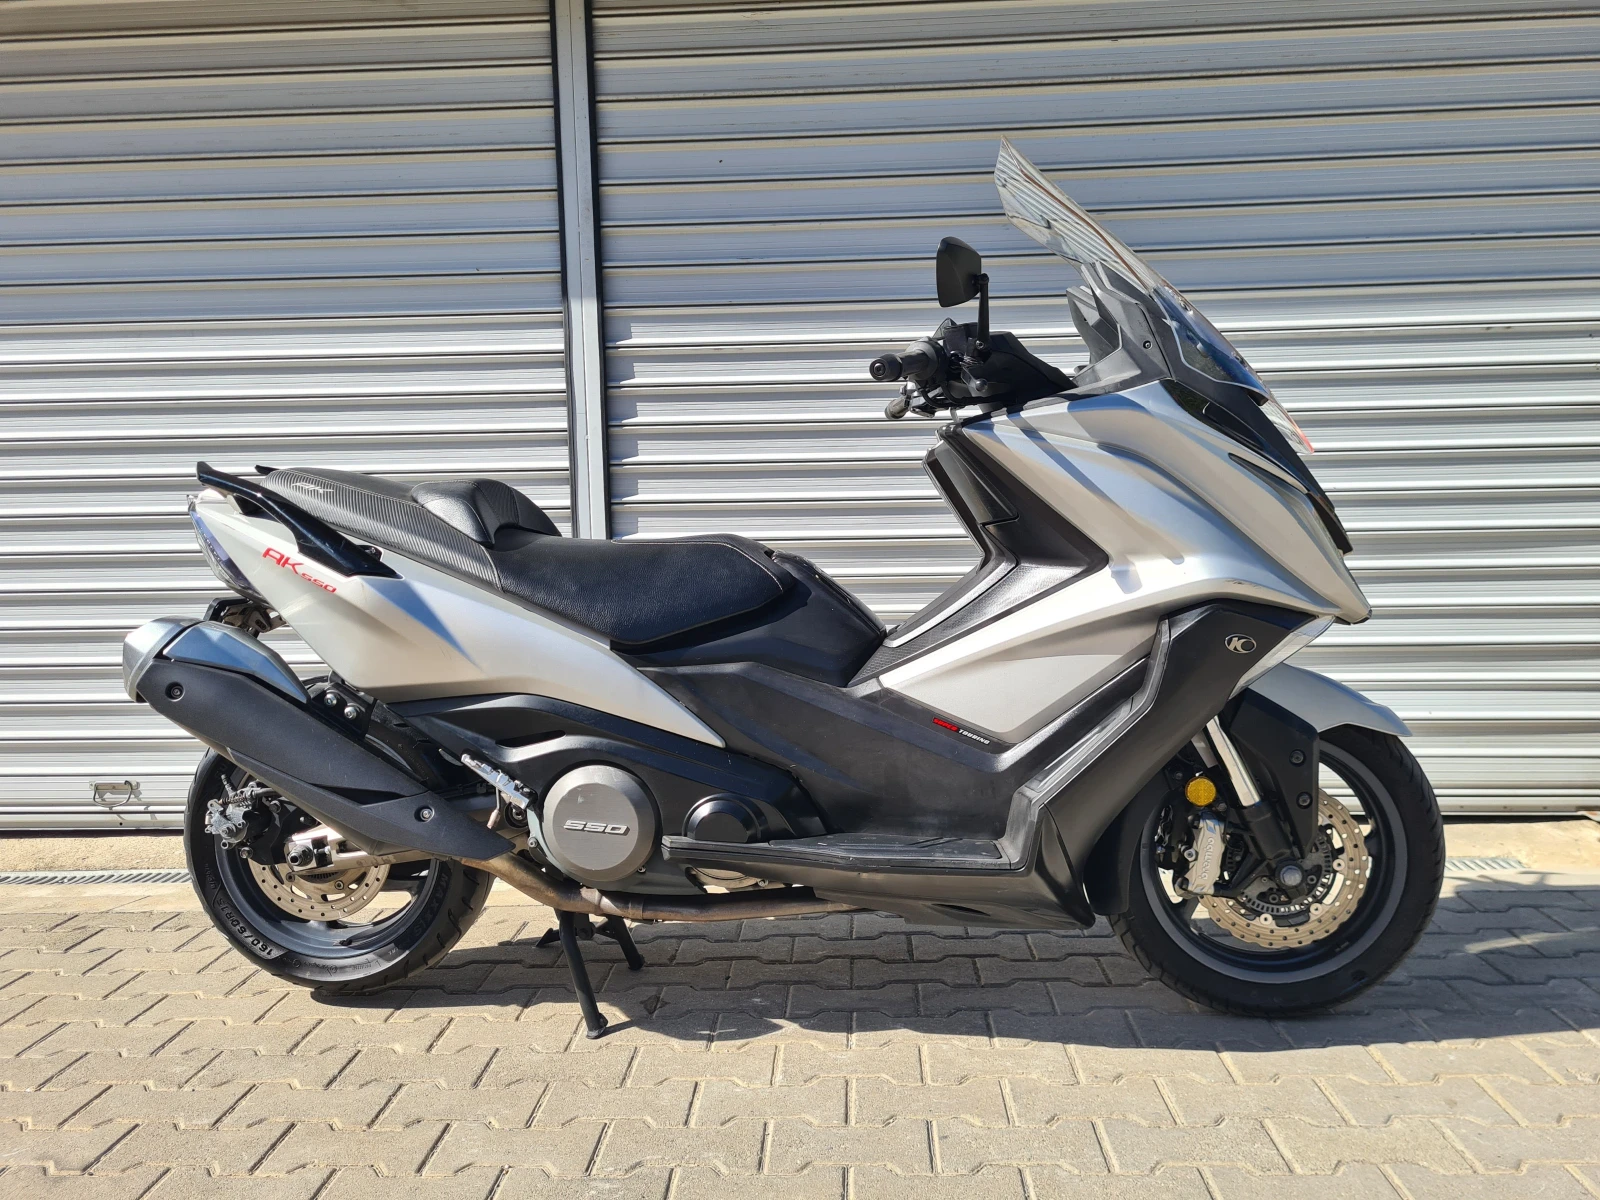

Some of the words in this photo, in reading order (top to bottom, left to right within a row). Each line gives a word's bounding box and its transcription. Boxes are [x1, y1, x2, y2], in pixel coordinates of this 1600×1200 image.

[262, 547, 304, 574] AK
[301, 573, 337, 593] 550
[959, 729, 990, 744] TOURING
[563, 819, 630, 836] 550
[1202, 836, 1215, 880] brembo
